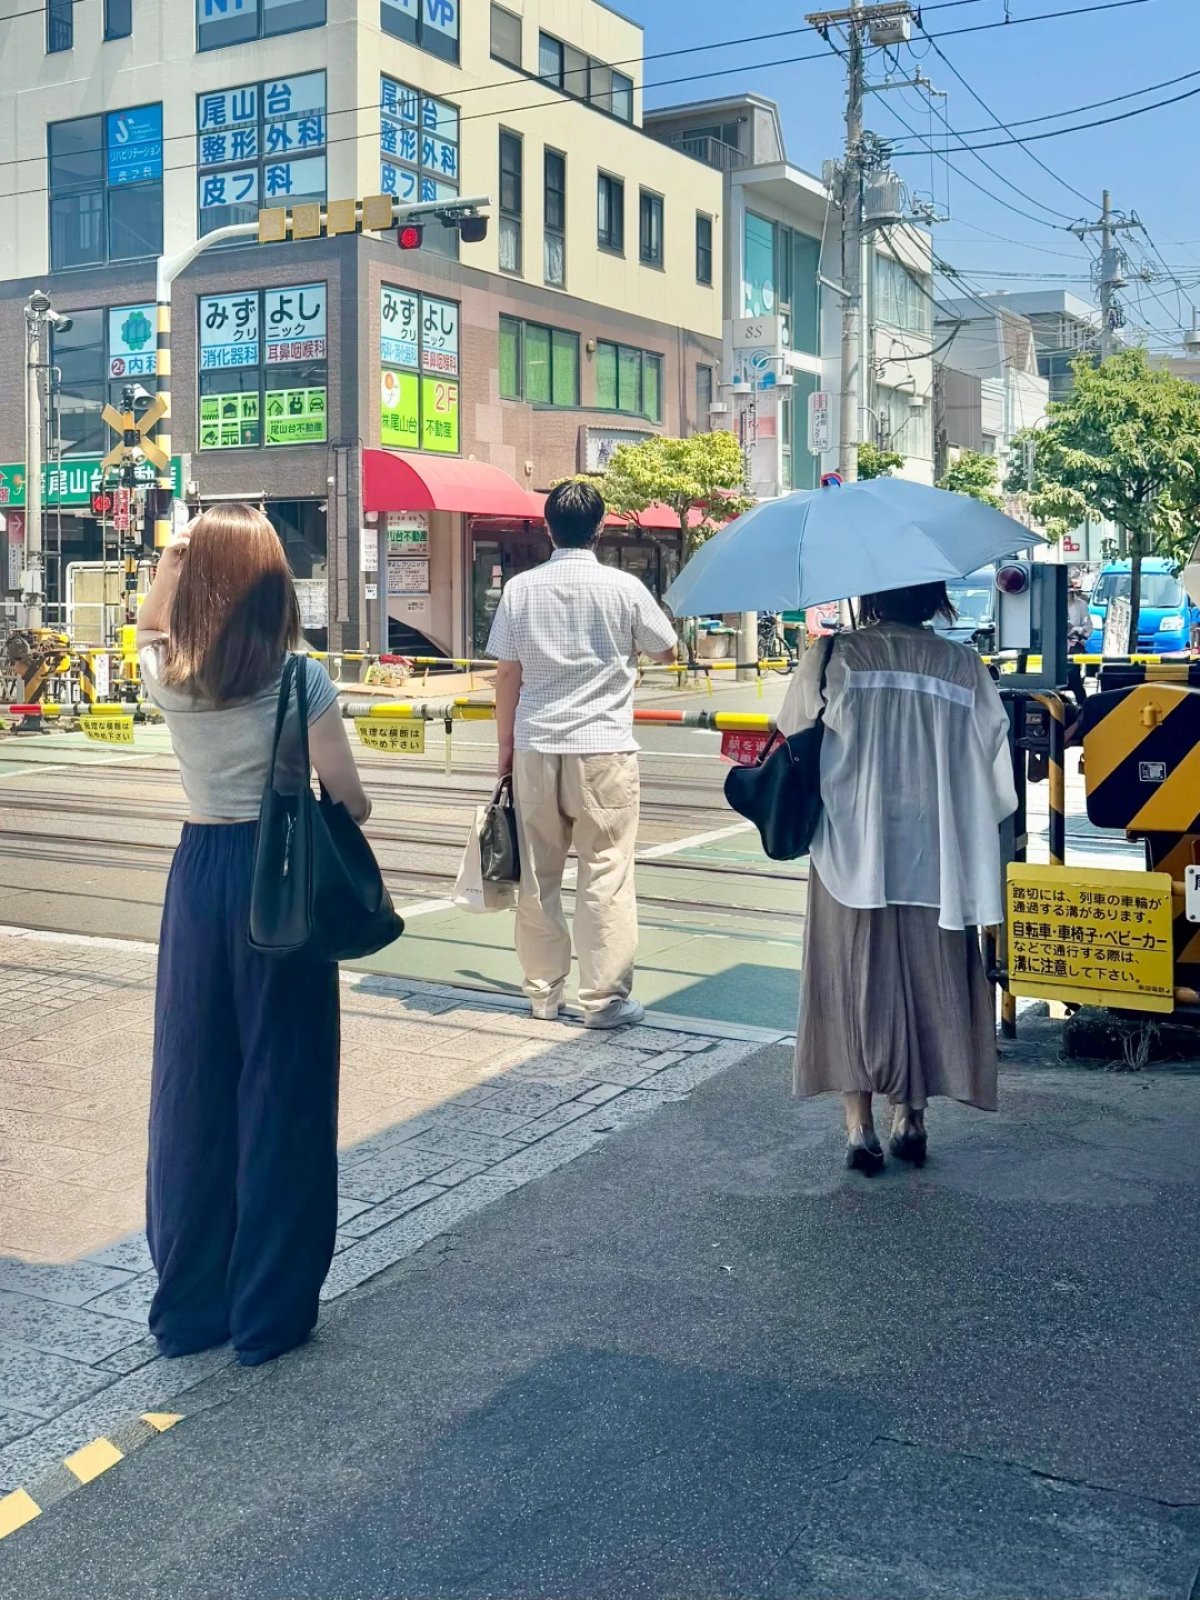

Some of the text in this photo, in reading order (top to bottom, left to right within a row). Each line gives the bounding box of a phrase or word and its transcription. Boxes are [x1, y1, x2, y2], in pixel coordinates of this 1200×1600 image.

[202, 84, 292, 128] 尾山台
[381, 80, 438, 131] 尾山台
[202, 116, 324, 165] 整形外科
[381, 120, 457, 176] 整形外科
[202, 163, 293, 208] 皮フ科
[381, 163, 437, 202] 皮フ科
[206, 292, 321, 330] みずよし
[383, 293, 454, 336] みずよし
[233, 323, 306, 342] クリニック
[401, 328, 446, 347] クリニック
[202, 344, 258, 368] 消化器科
[267, 340, 327, 361] 耳鼻咽喉科
[436, 384, 457, 412] 2F
[270, 422, 323, 435] 尾山台不動産
[1012, 887, 1162, 911] 踏切には、列車の車輪が
[1012, 900, 1153, 925] 通過する溝があります。
[1013, 921, 1168, 949] 自転車・車椅子・ベビーカー
[1013, 940, 1141, 964] などで通行する際は、
[1013, 955, 1141, 984] 溝に注意して下さい。
